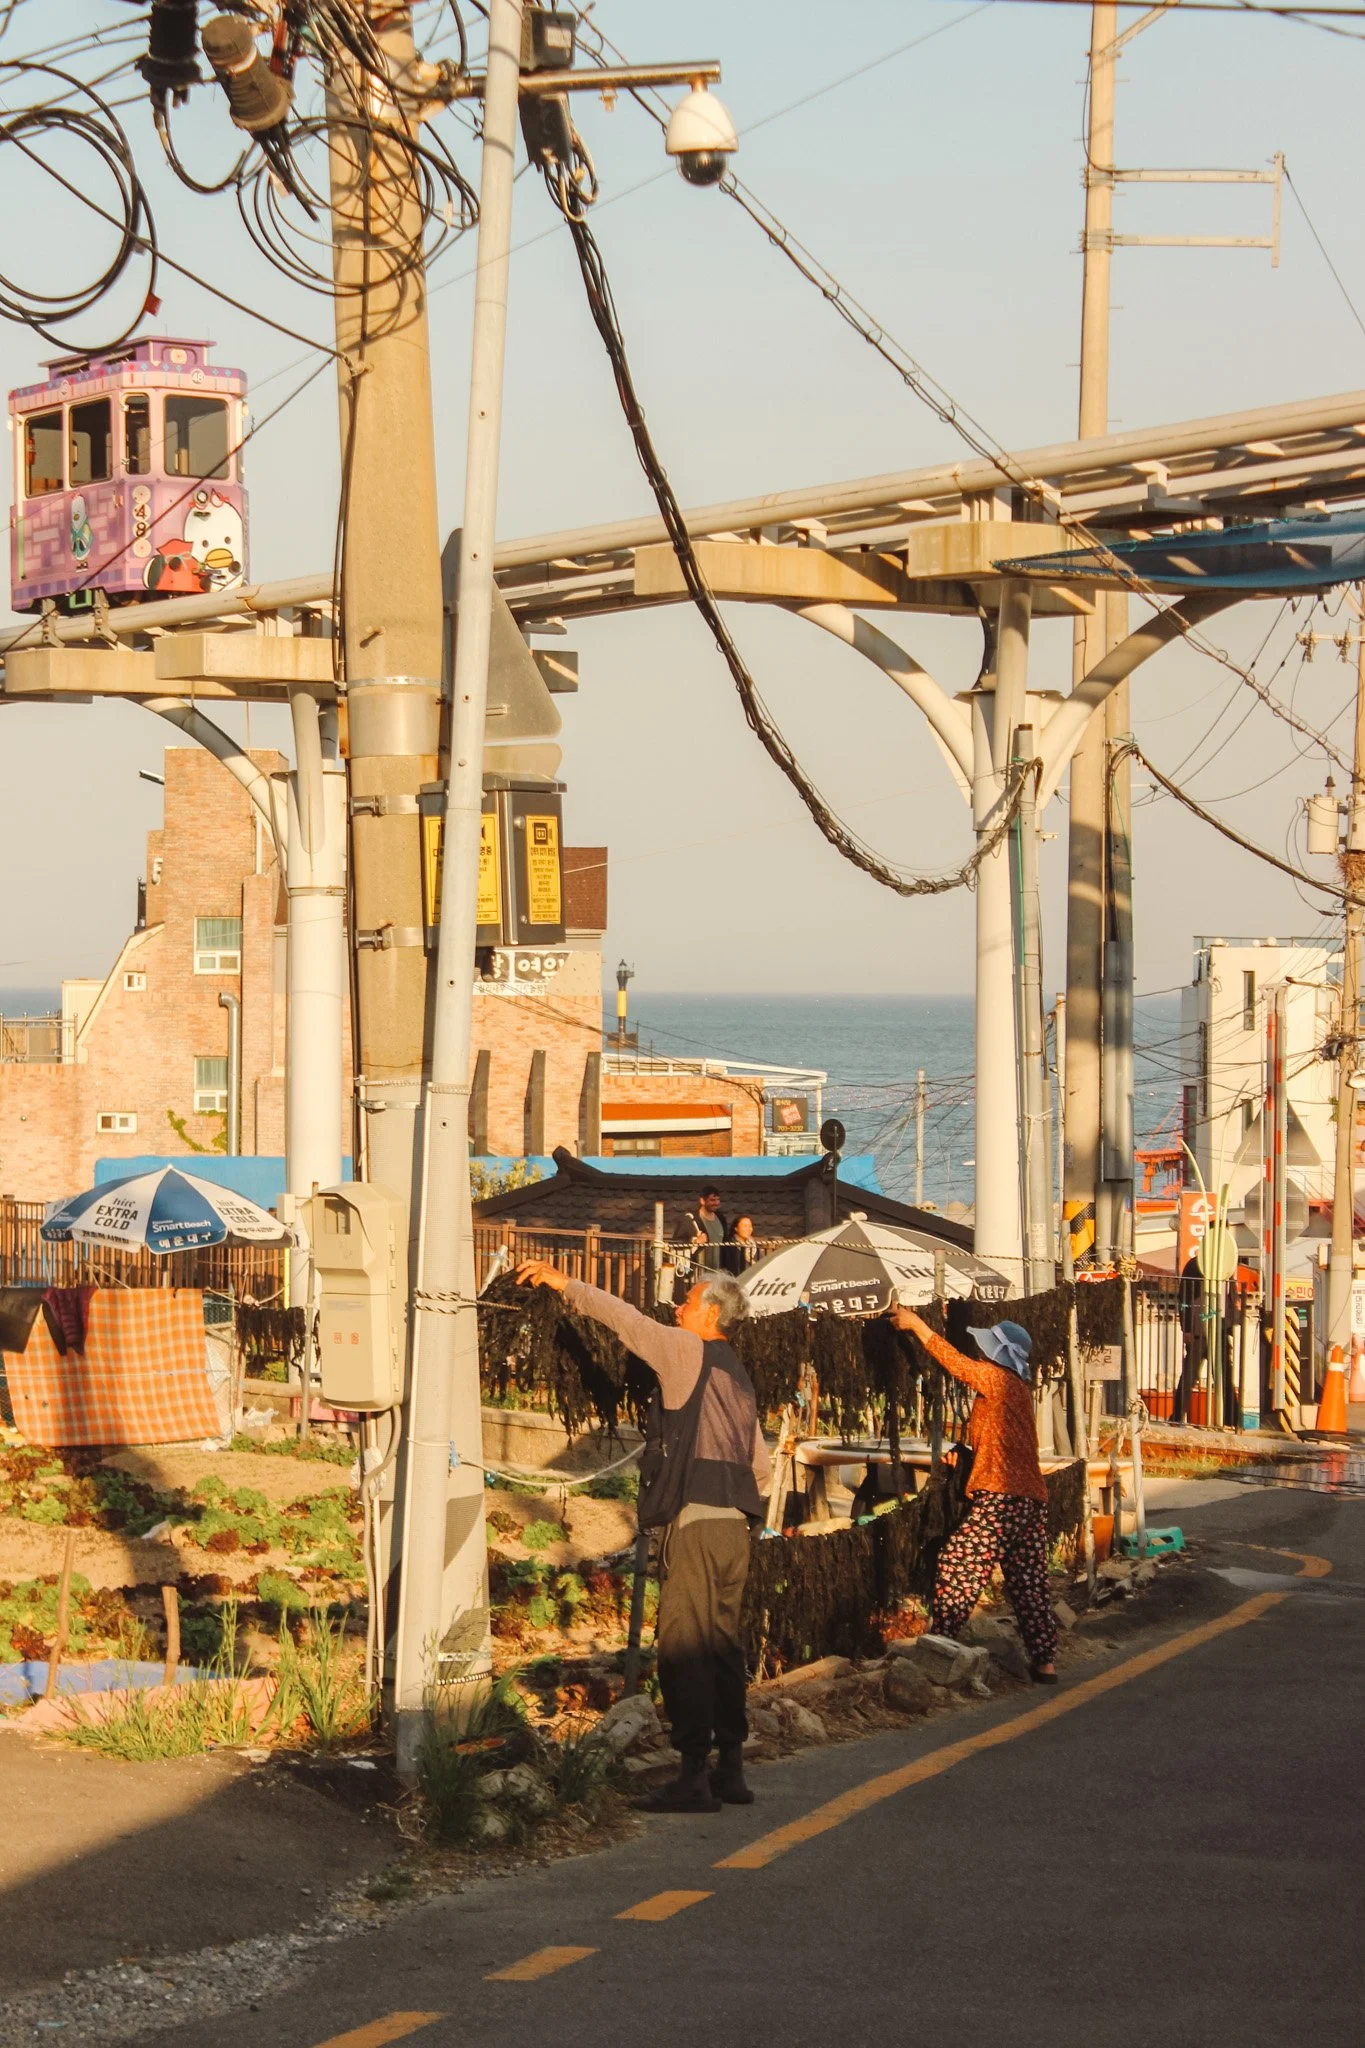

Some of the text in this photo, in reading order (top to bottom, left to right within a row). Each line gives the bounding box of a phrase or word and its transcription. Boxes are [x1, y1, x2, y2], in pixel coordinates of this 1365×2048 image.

[96, 1205, 138, 1220] EXTRA
[217, 1207, 255, 1216] EXTRA
[95, 1216, 131, 1230] COLD
[230, 1215, 260, 1223] COLD
[749, 1277, 796, 1297] hite
